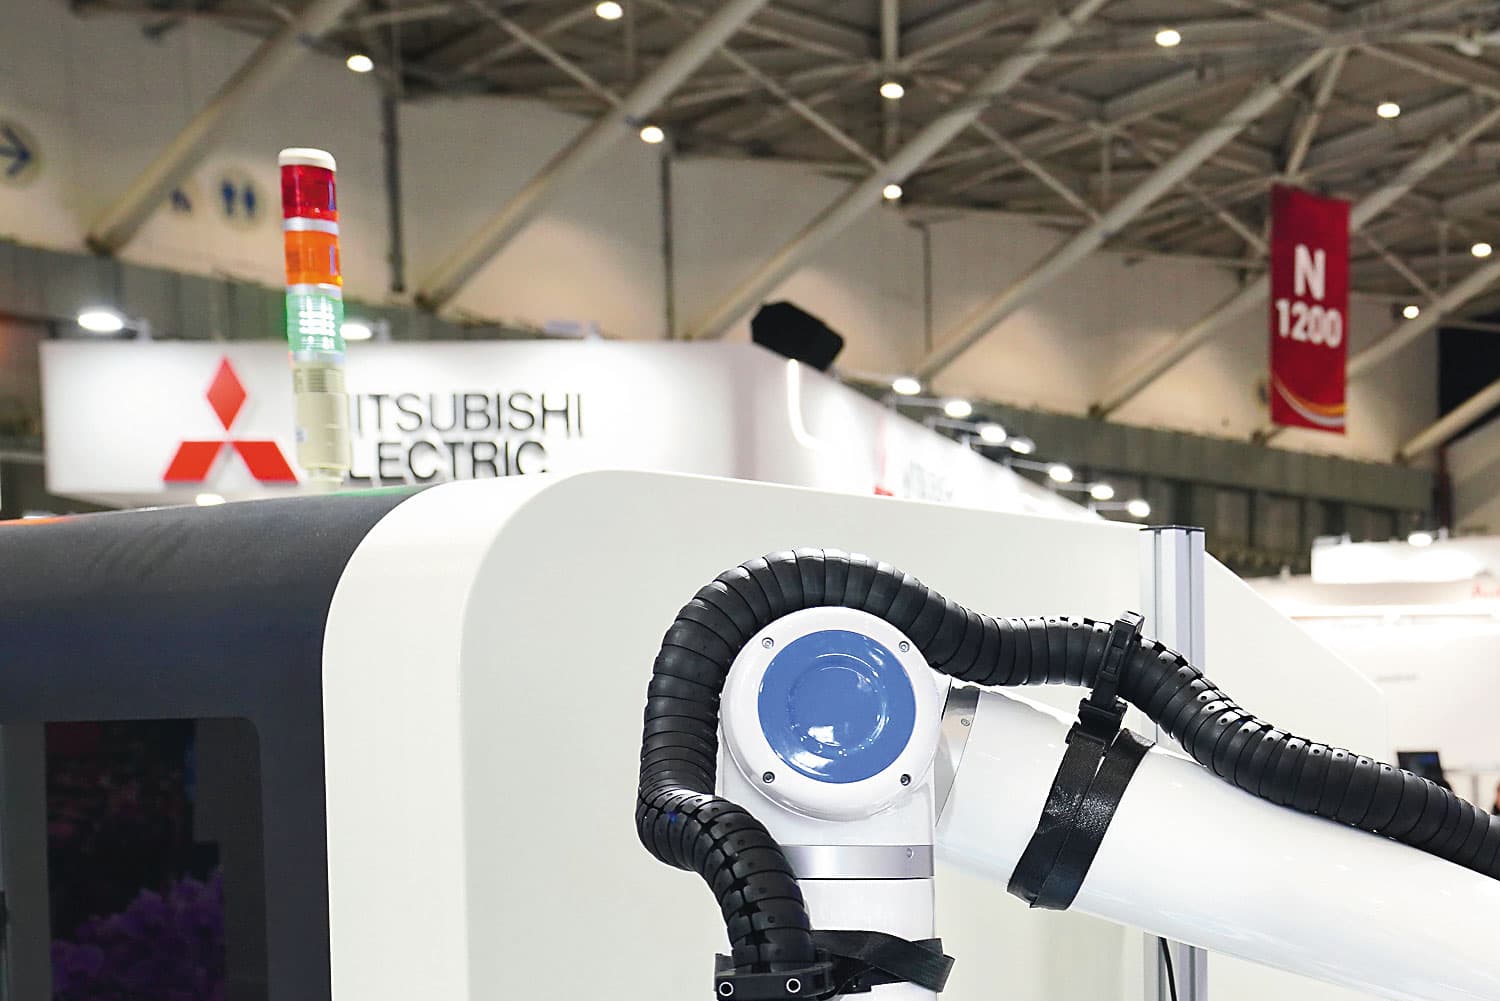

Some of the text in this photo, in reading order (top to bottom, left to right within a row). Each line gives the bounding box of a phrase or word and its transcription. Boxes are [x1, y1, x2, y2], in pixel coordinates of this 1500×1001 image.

[1294, 243, 1326, 301] N
[1275, 298, 1343, 349] 1200
[355, 392, 582, 434] ITSUBISHI
[350, 440, 547, 480] LECTRIC
